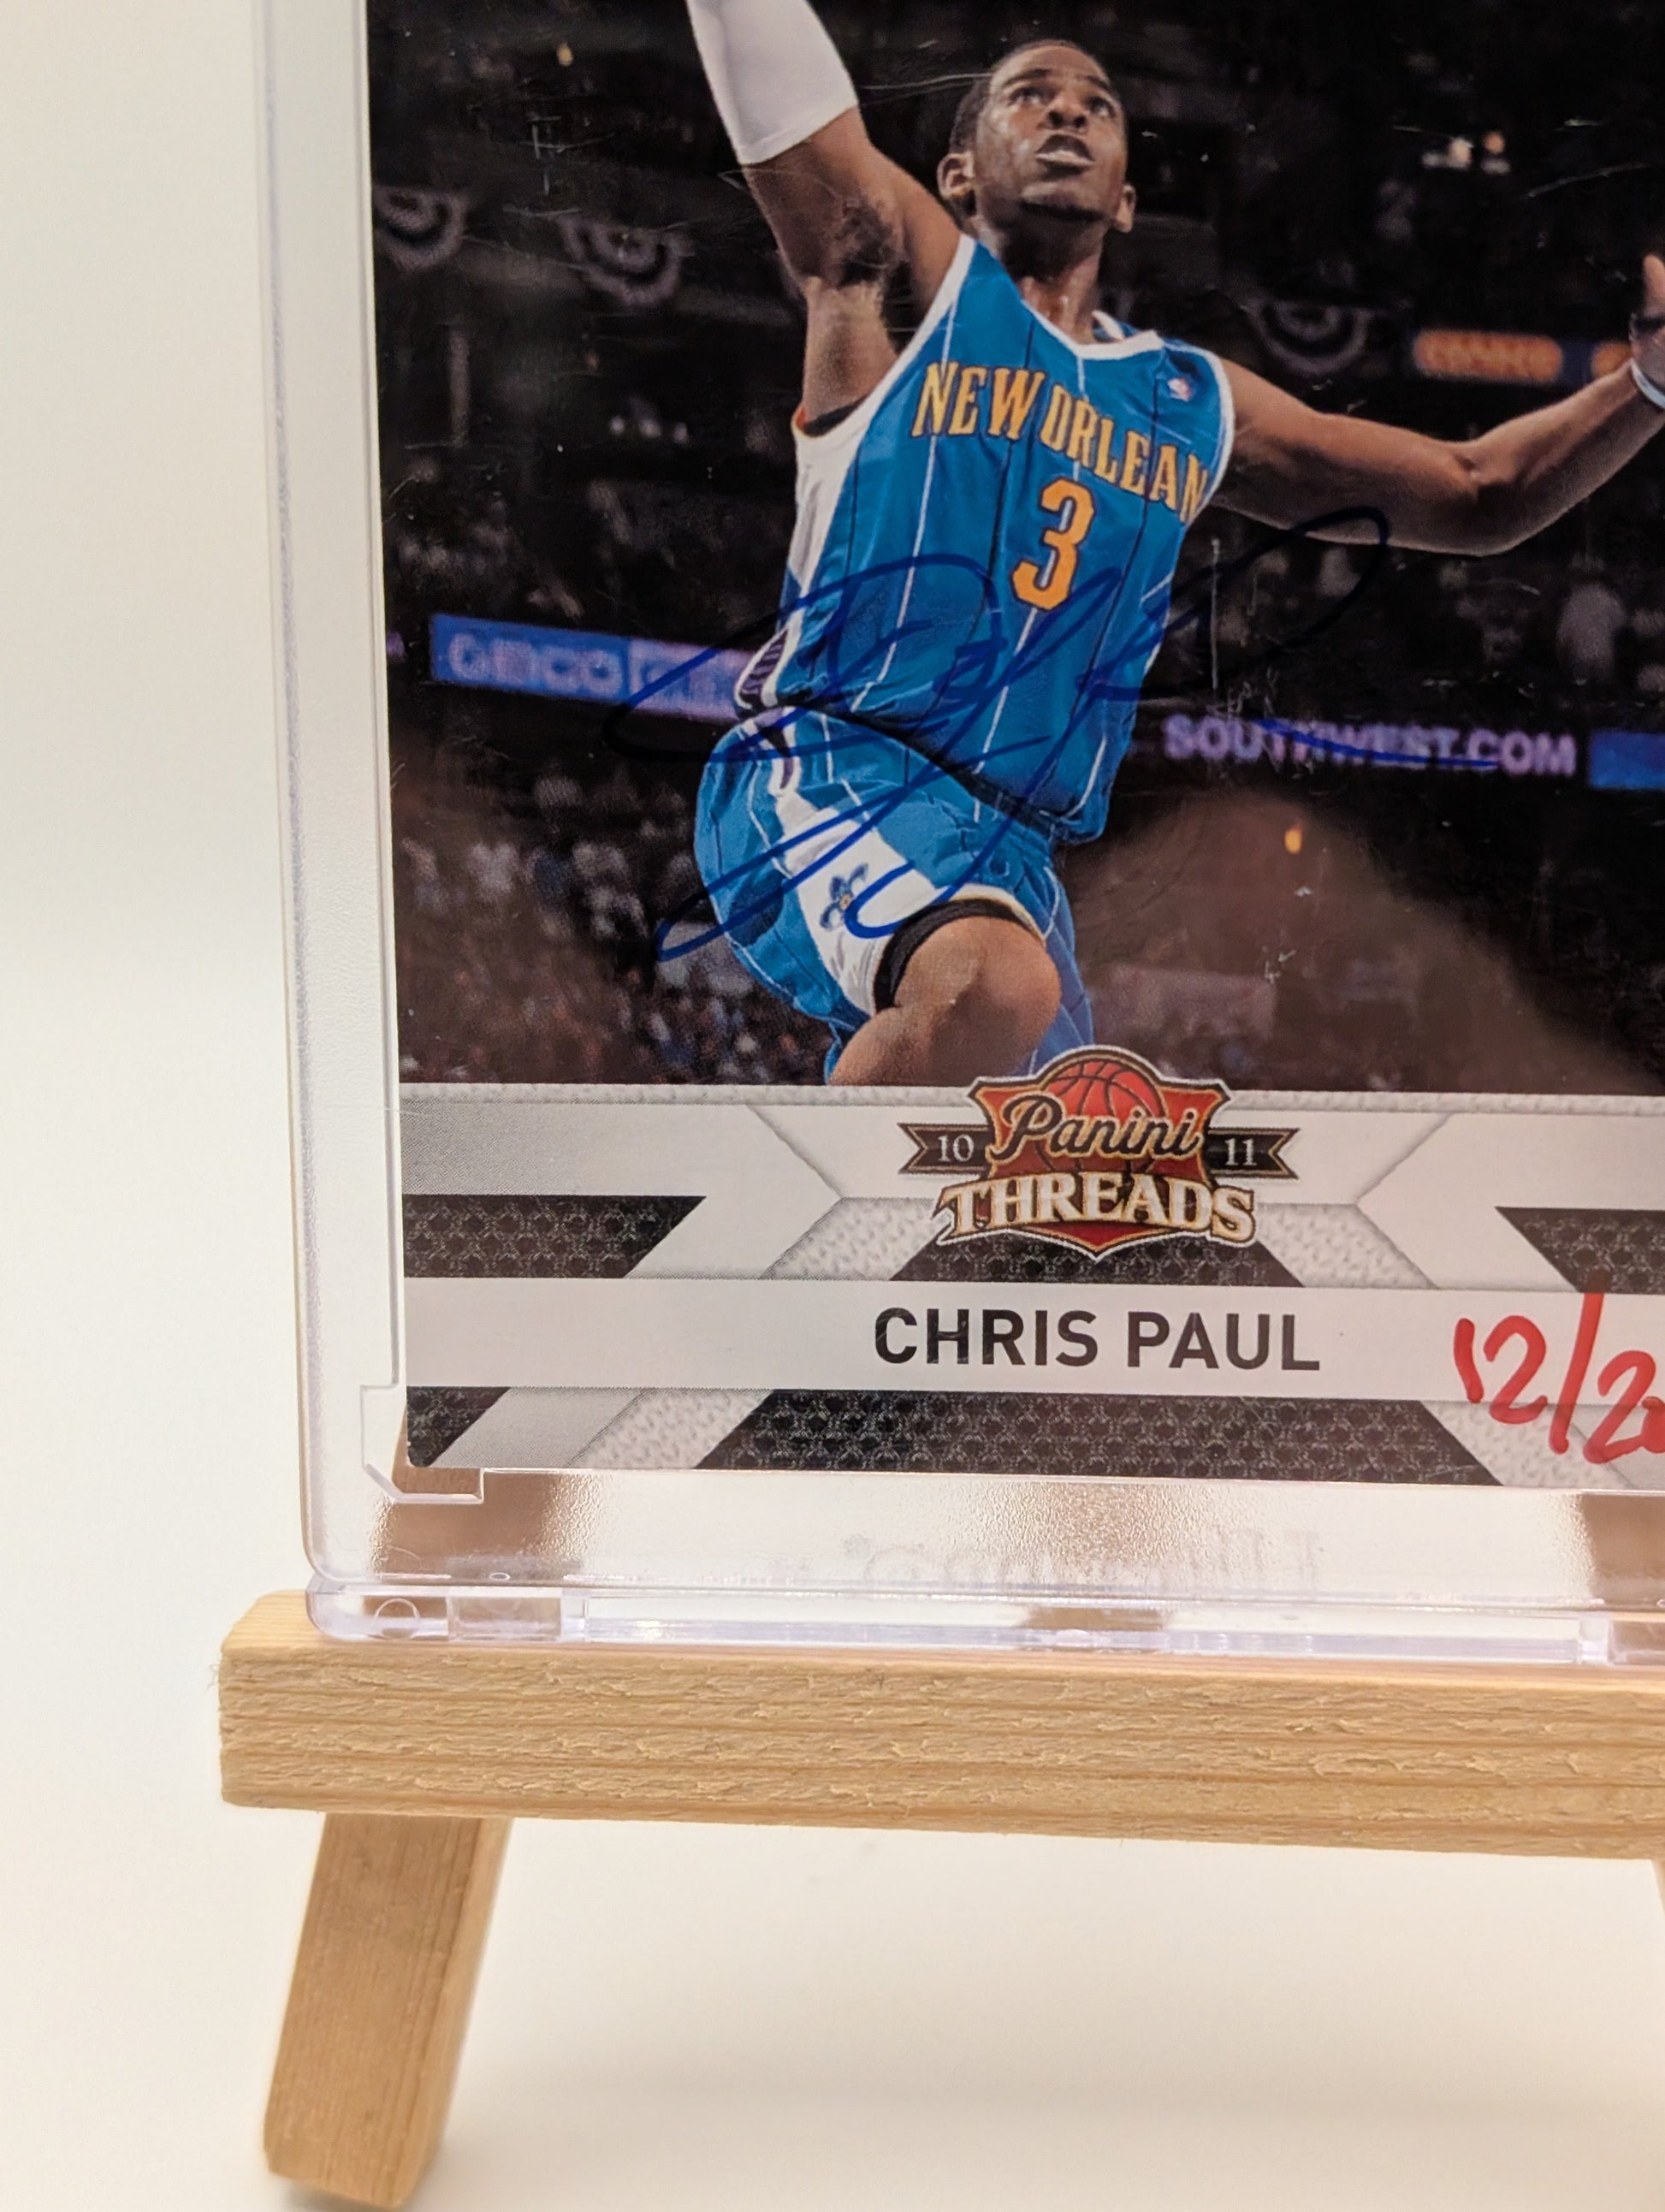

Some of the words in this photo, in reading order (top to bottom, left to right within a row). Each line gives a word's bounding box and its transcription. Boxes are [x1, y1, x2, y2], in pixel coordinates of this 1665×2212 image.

[910, 361, 1046, 441] NEW
[1010, 475, 1096, 611] 3
[1163, 712, 1576, 776] SOUTHWEST.COM
[938, 1134, 975, 1163] 10
[987, 1093, 1205, 1161] Panini
[1224, 1137, 1258, 1166] 11
[939, 1171, 1256, 1243] THREADS
[874, 1307, 1099, 1367] CHRIS
[1126, 1312, 1321, 1372] PAUL
